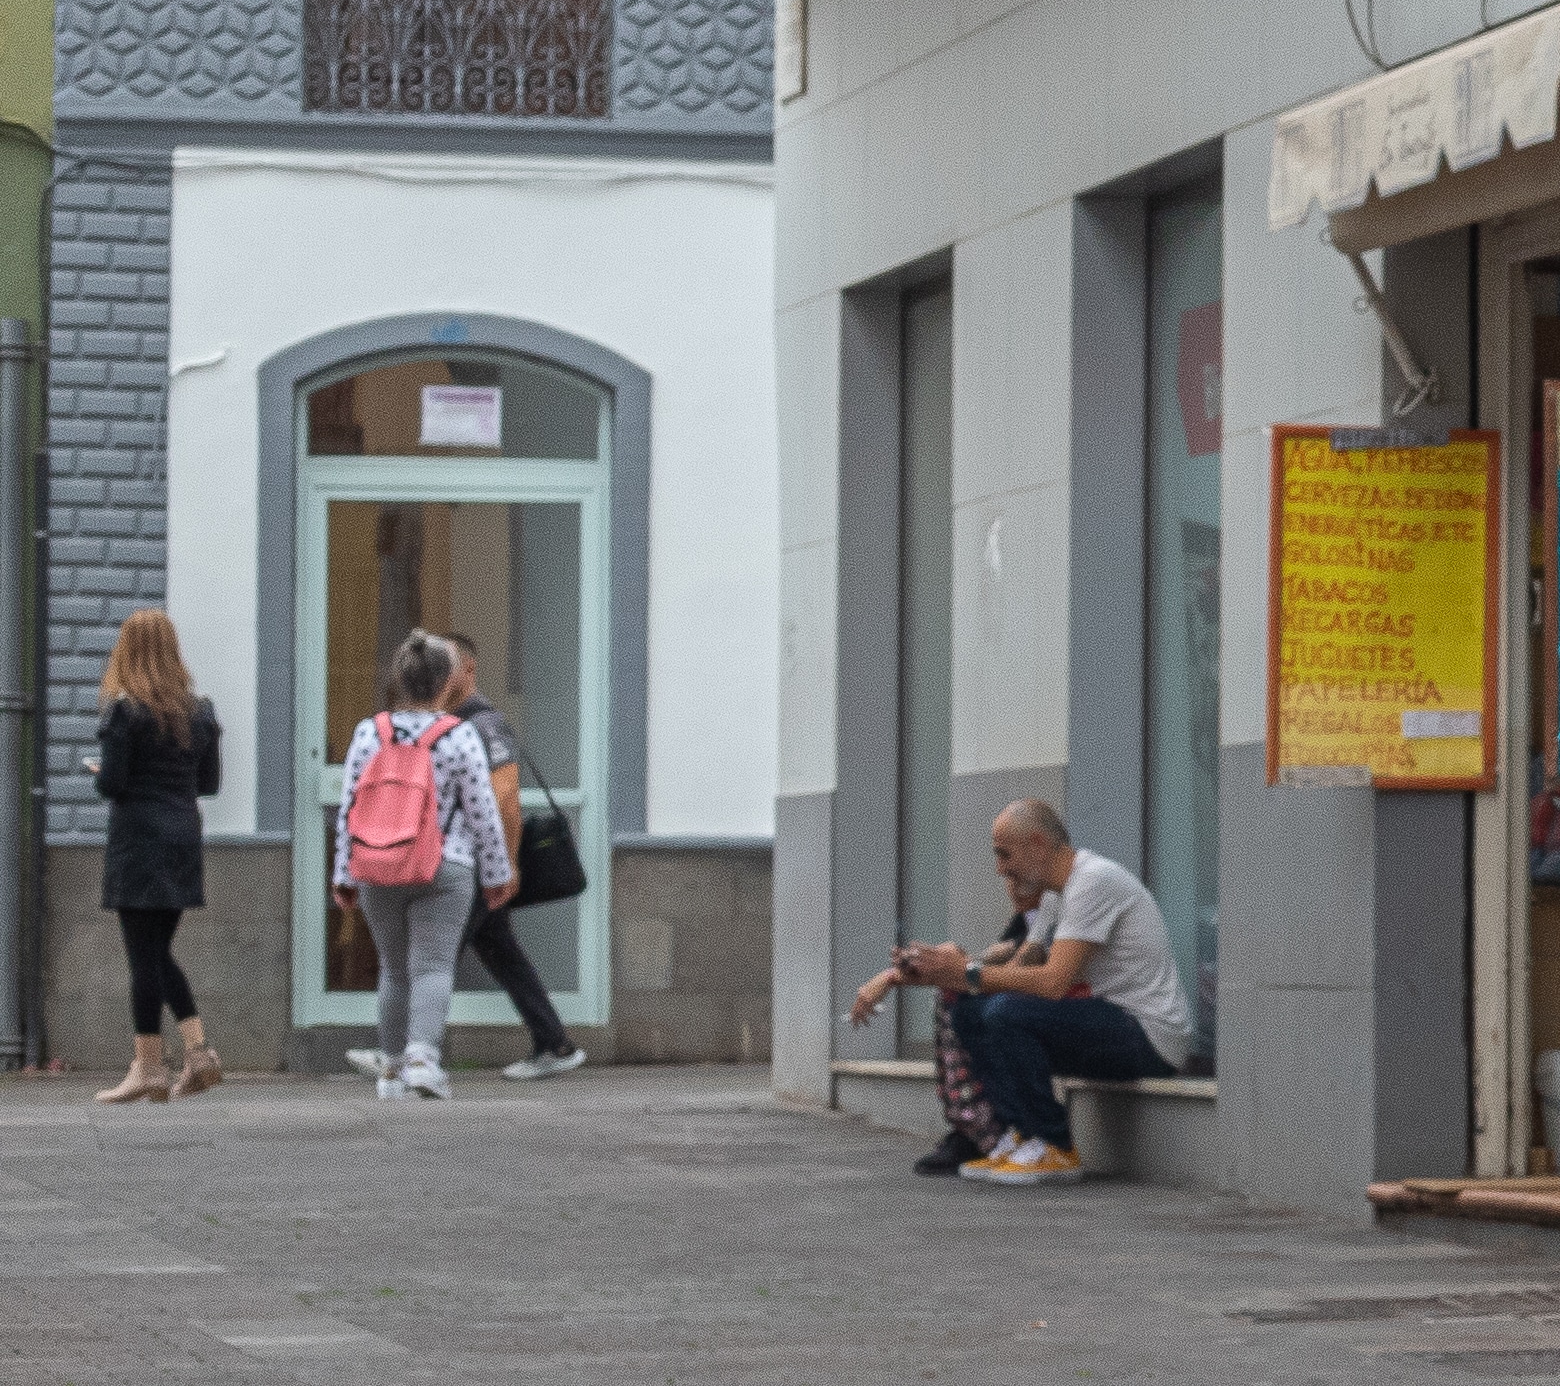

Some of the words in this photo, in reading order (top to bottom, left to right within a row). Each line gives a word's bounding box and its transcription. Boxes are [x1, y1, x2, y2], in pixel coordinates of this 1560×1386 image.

[1283, 573, 1389, 605] TABACOS
[1282, 607, 1416, 639] RECARGAS
[1281, 639, 1416, 673] JUGUETES
[1281, 670, 1443, 704] PAPELERÍA
